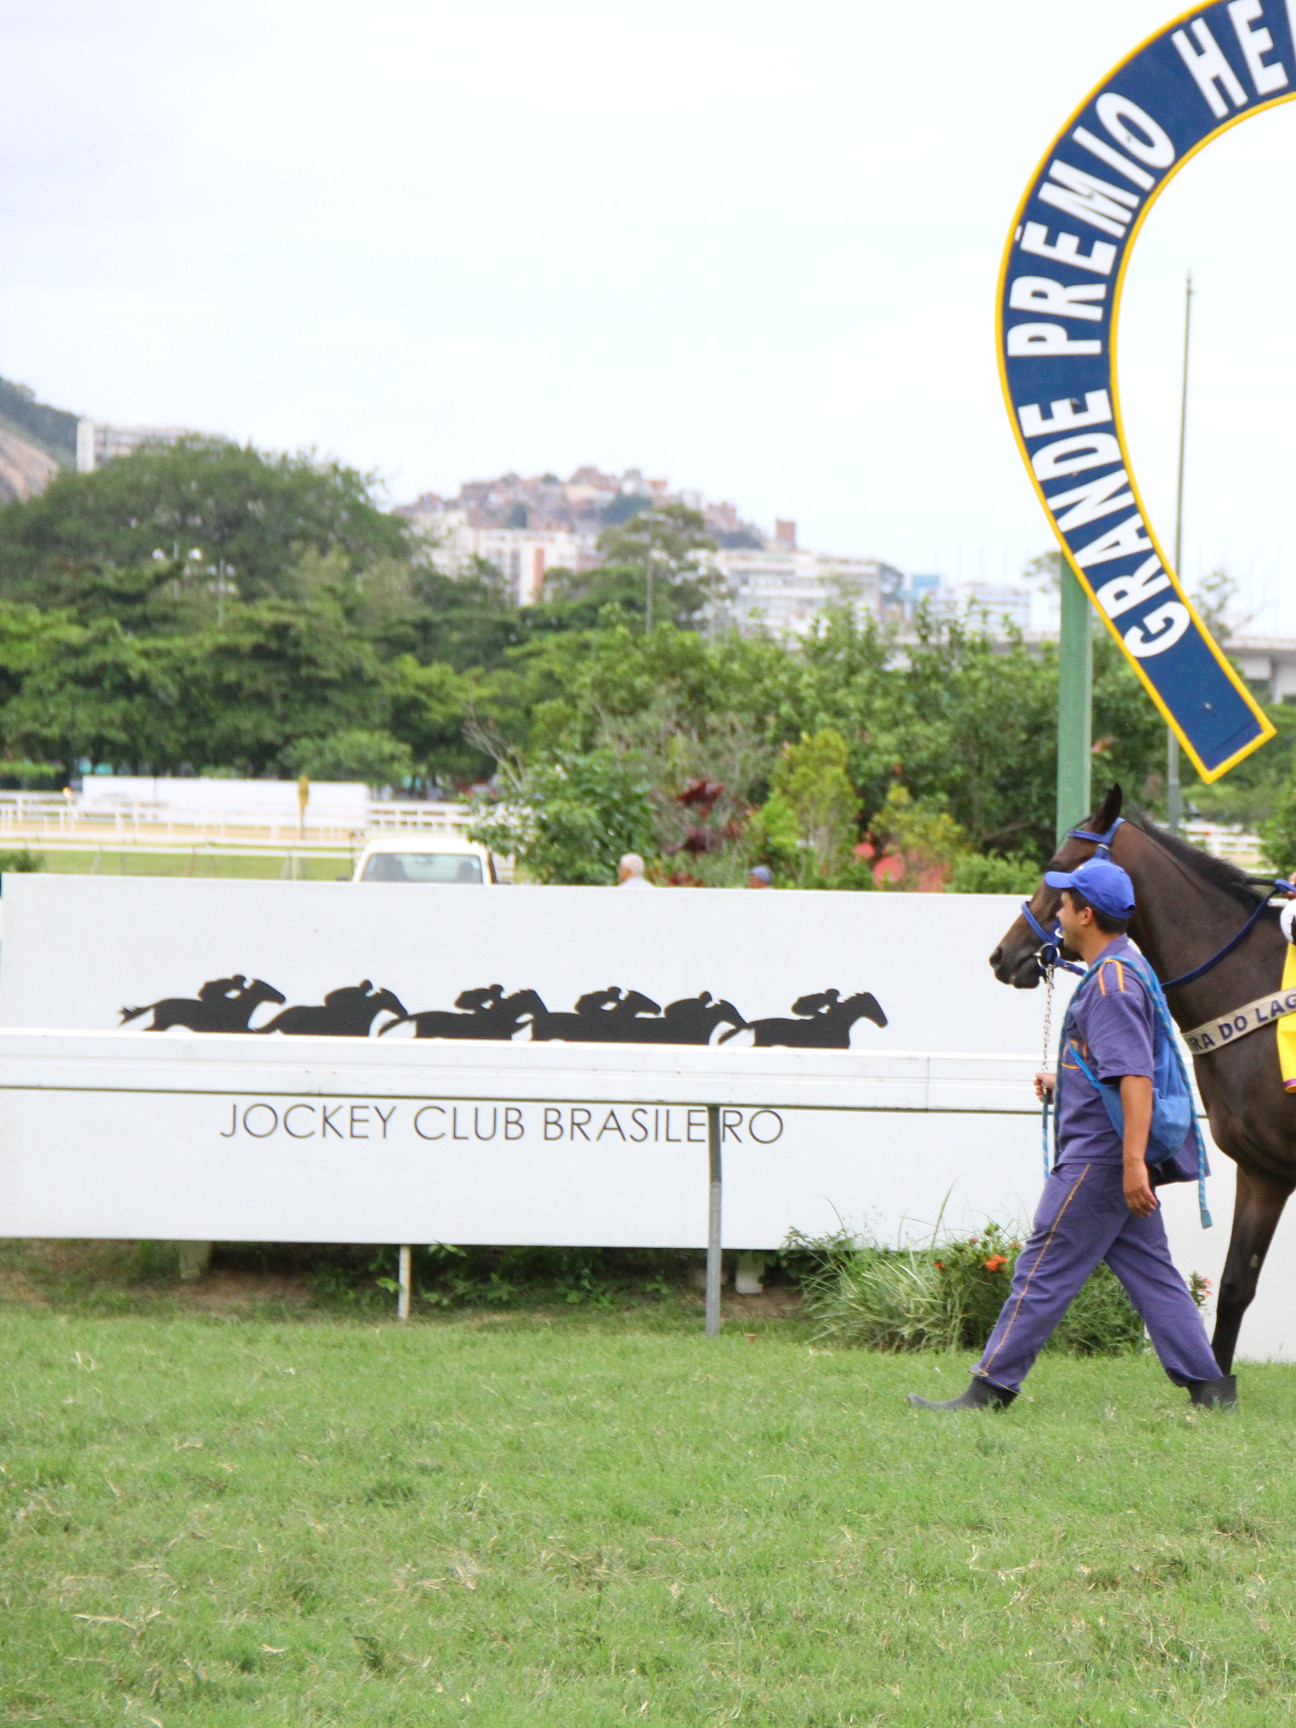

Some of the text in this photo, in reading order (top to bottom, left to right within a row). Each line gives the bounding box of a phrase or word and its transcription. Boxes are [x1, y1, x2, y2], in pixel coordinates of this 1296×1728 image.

[1016, 389, 1192, 658] GRANDE
[1217, 1015, 1249, 1041] DO
[220, 1102, 784, 1144] JOCKEY CLUB BRASILERO
